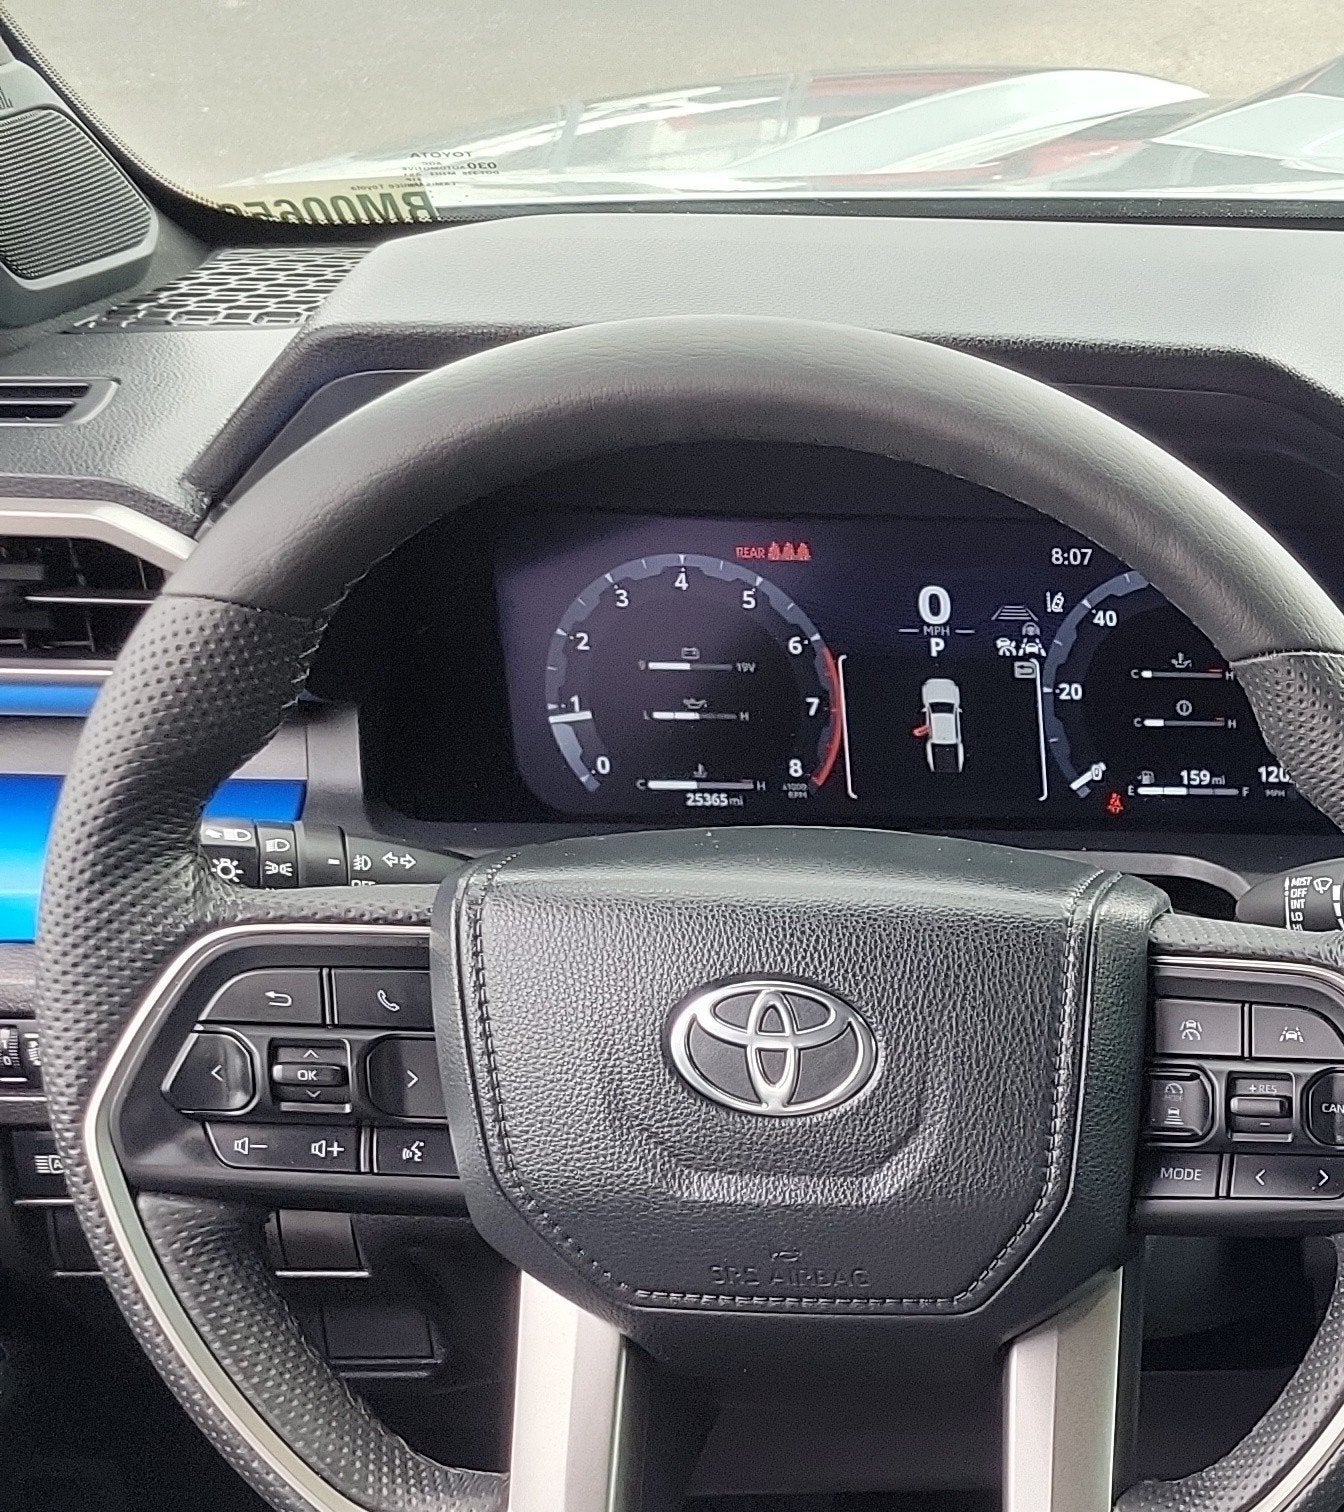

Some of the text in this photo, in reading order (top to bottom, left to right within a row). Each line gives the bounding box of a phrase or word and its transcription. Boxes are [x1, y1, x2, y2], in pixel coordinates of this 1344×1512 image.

[1050, 548, 1093, 566] 8:07
[674, 572, 689, 590] 4
[615, 588, 630, 608] 3
[742, 588, 756, 608] 5
[918, 585, 952, 625] 0
[1093, 610, 1118, 628] 40
[923, 625, 951, 637] MPH
[575, 632, 591, 651] 2
[788, 637, 803, 655] 6
[929, 637, 946, 657] P
[1059, 683, 1083, 701] 20
[805, 697, 820, 716] 7
[596, 756, 611, 775] 0
[788, 758, 803, 777] 8
[1180, 769, 1211, 786] 159
[685, 792, 729, 807] 25365
[297, 1070, 317, 1082] OK
[1160, 1166, 1202, 1181] MODE
